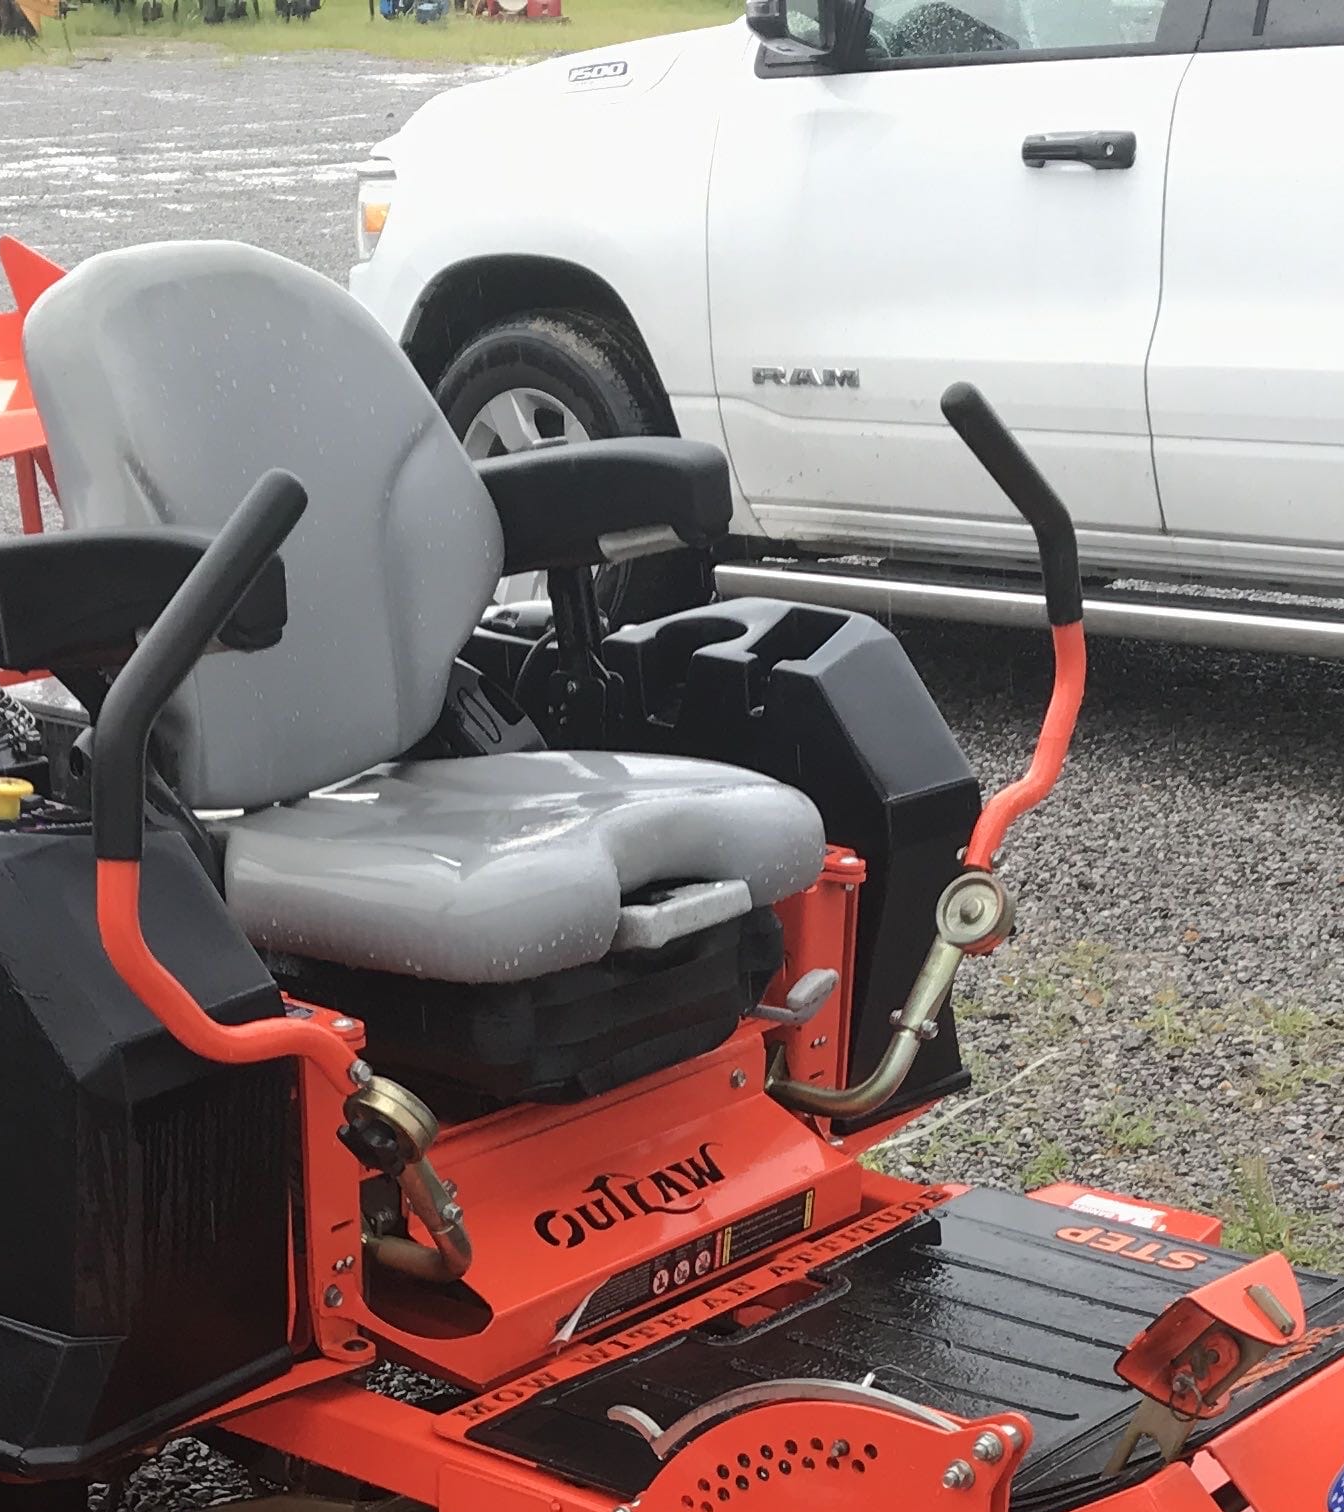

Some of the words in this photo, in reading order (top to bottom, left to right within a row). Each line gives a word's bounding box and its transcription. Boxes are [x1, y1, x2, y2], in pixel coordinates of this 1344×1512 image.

[568, 61, 627, 82] 1500
[751, 366, 860, 388] RAM
[1056, 1226, 1208, 1271] STEP
[453, 1370, 560, 1422] MOW
[570, 1311, 690, 1365] WITH
[702, 1280, 756, 1311] AN
[768, 1188, 950, 1279] ATTITUDE
